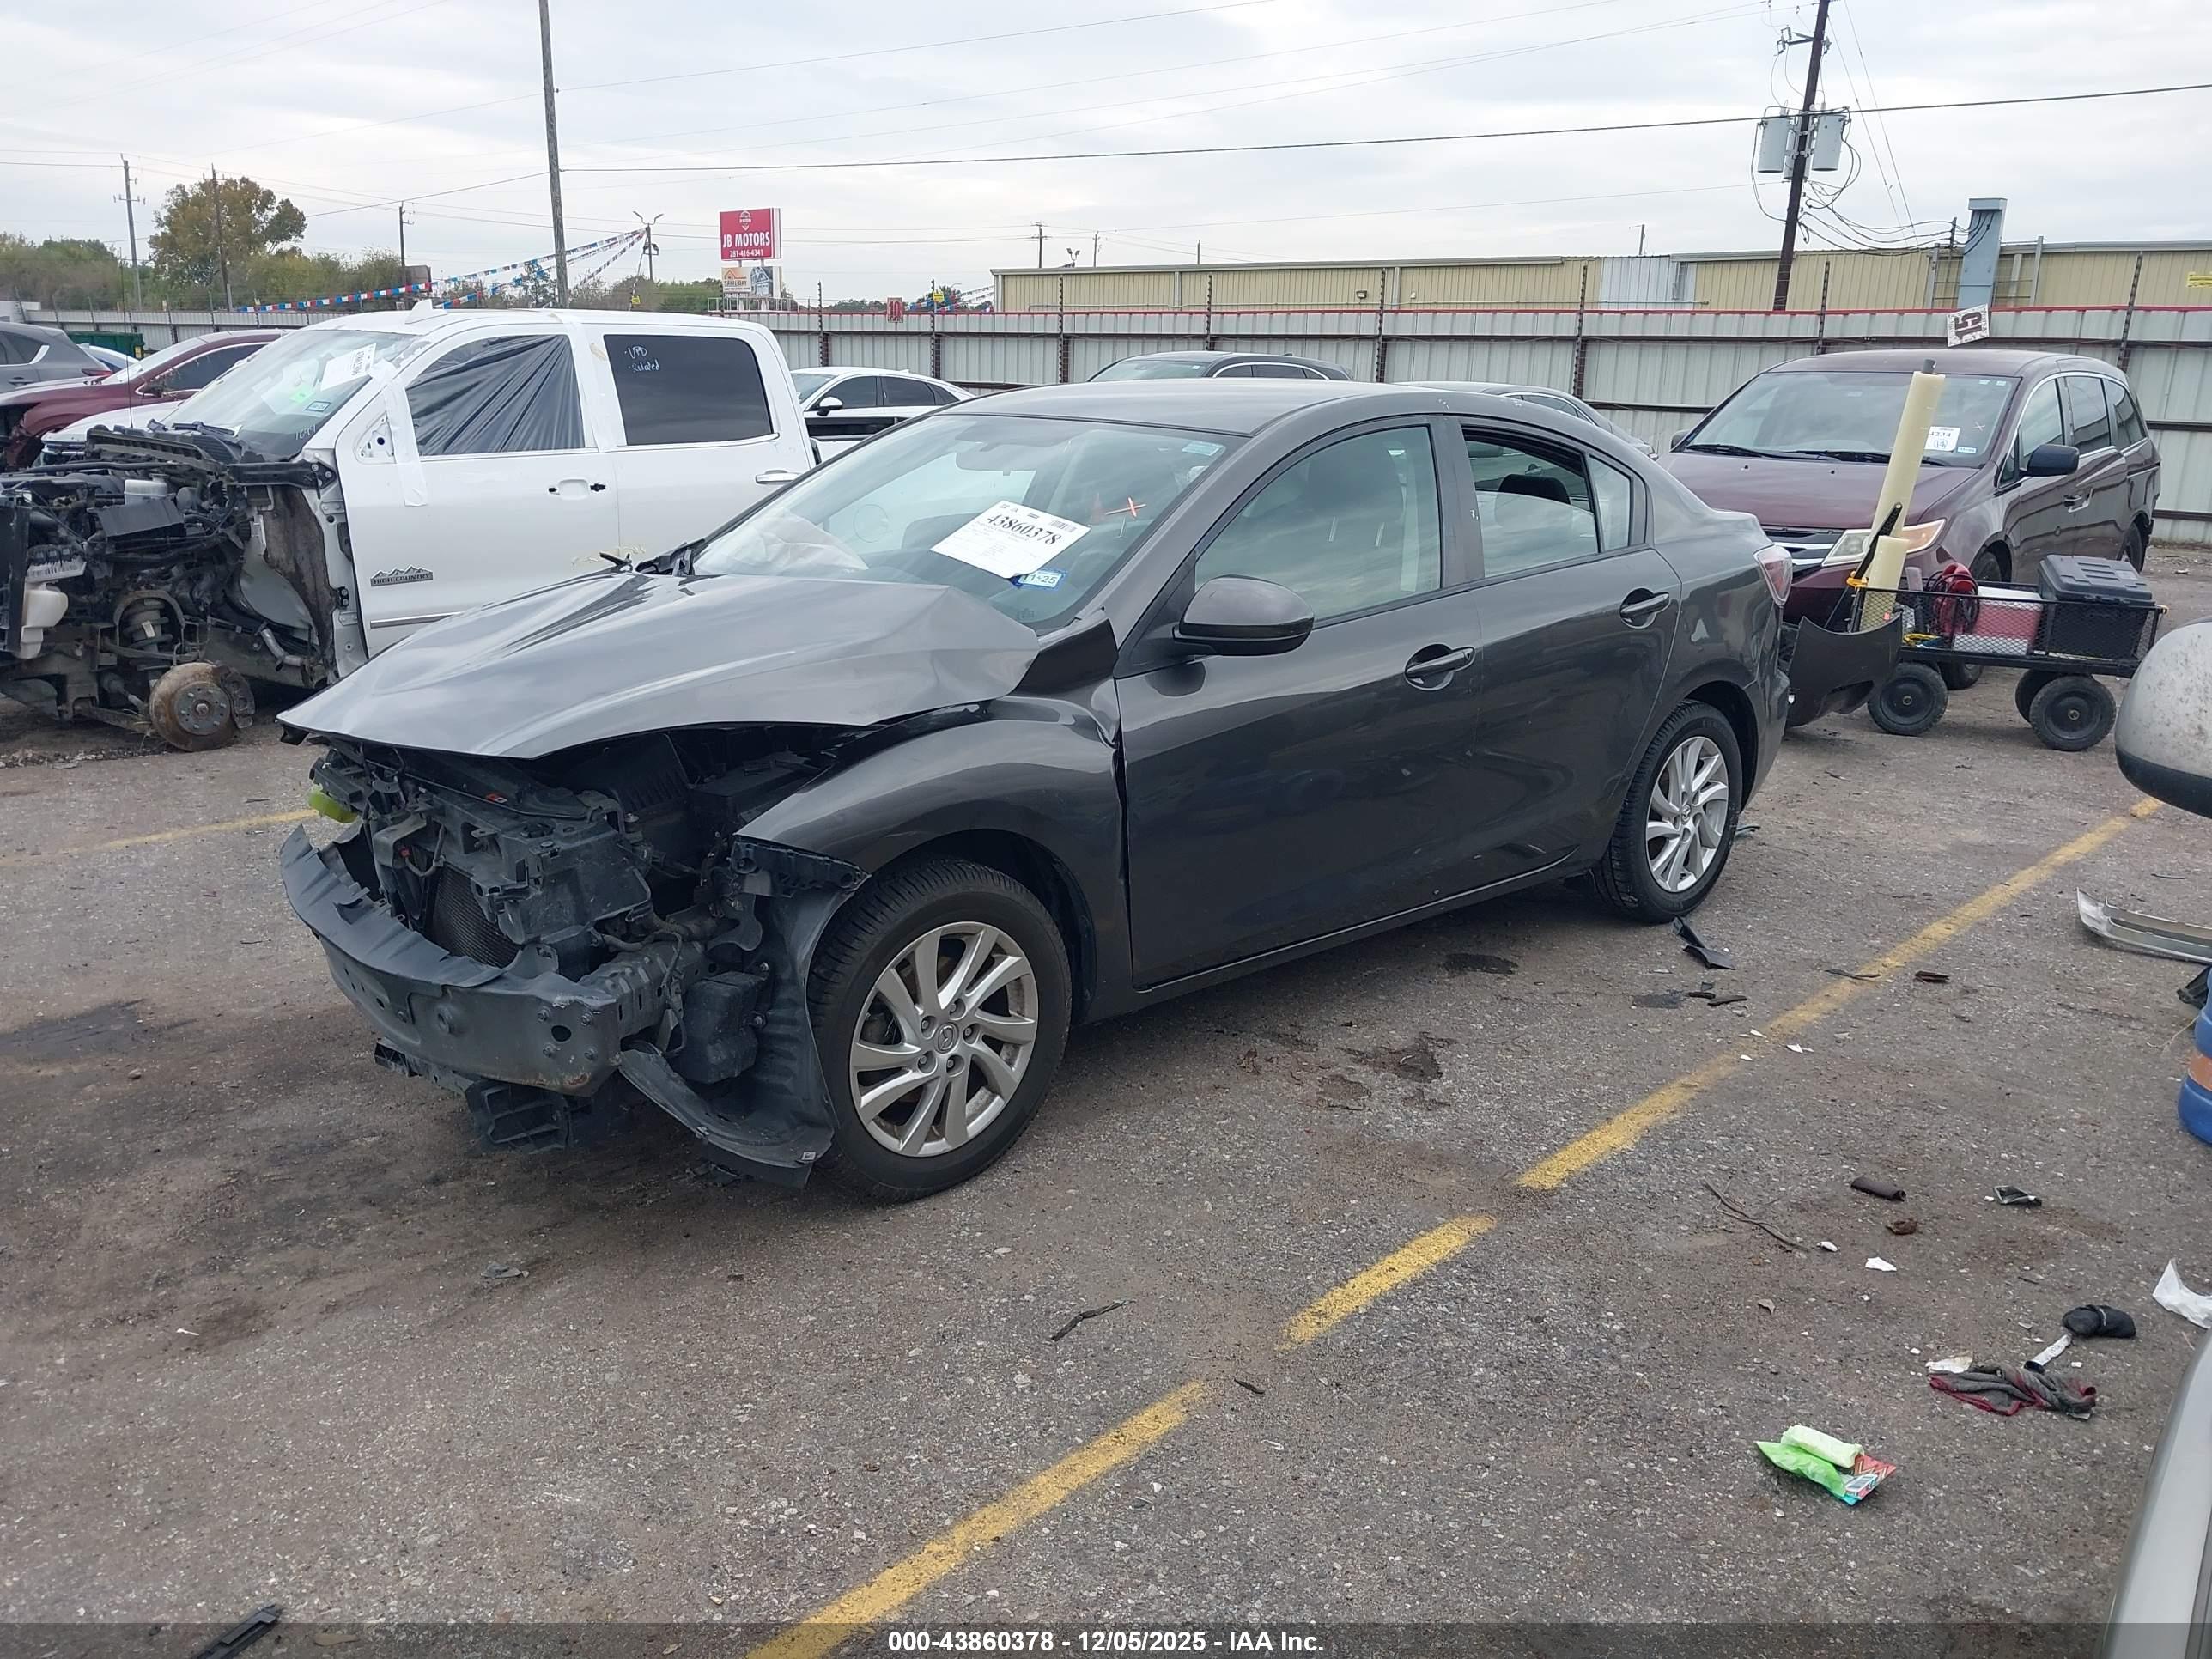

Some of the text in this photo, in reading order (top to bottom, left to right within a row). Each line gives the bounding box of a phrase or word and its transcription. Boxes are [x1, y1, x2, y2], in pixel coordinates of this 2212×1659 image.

[723, 232, 770, 247] JB MOTORS
[889, 301, 902, 317] 10
[1954, 312, 1982, 339] 15
[987, 514, 1062, 545] 43860378
[395, 574, 430, 583] COUNTRY
